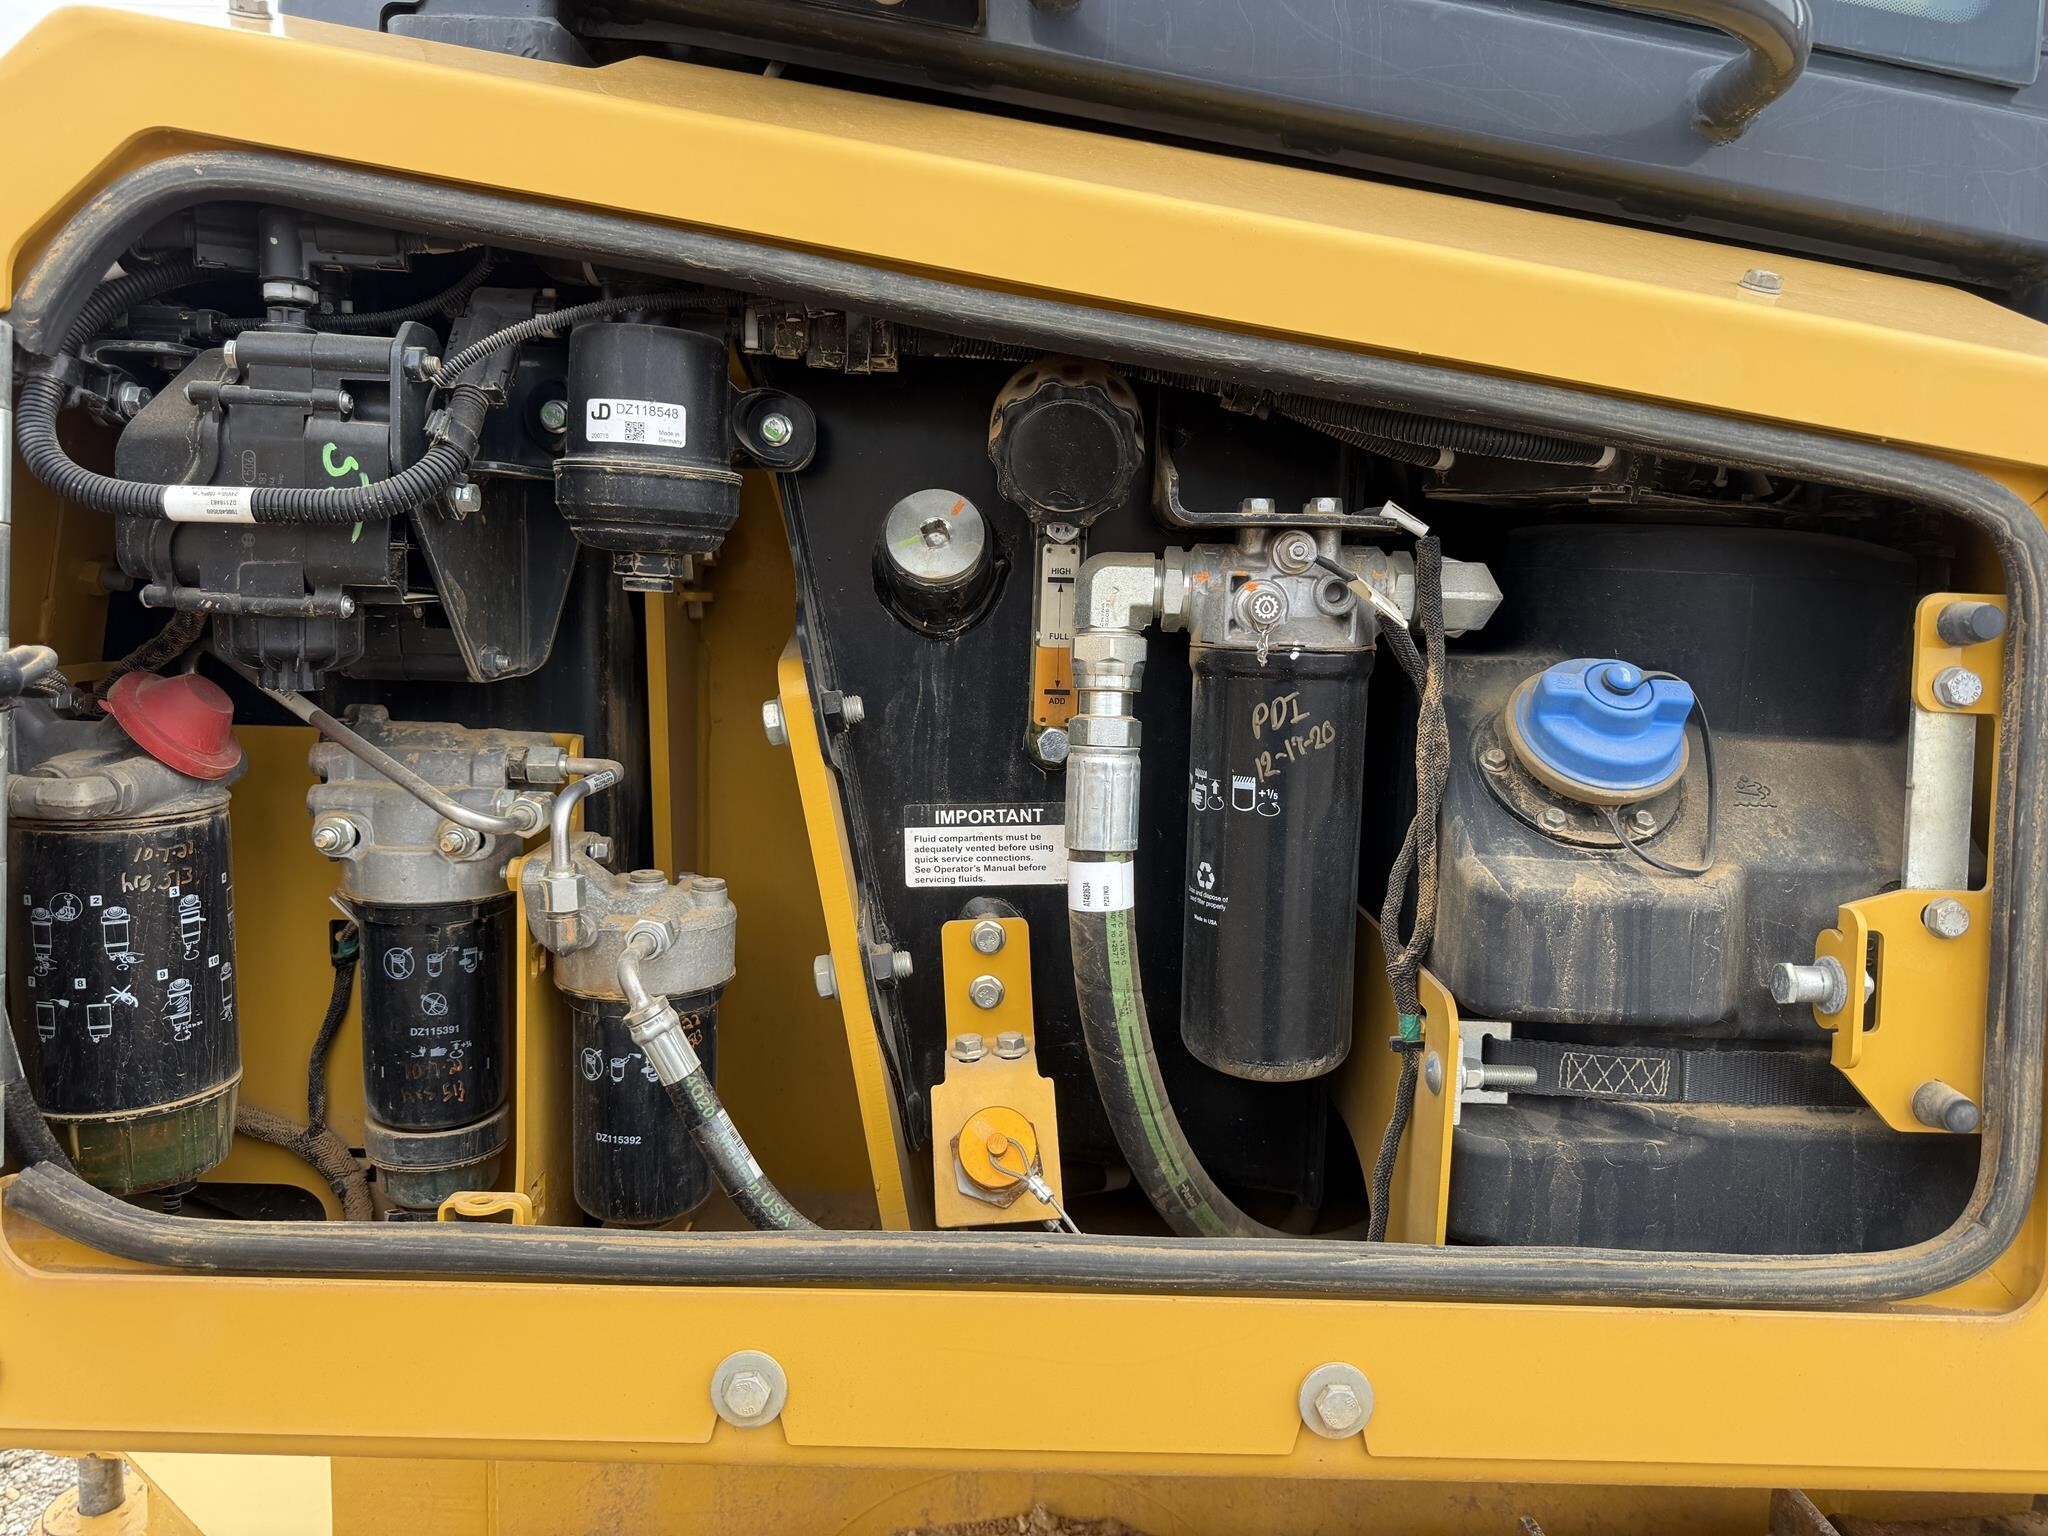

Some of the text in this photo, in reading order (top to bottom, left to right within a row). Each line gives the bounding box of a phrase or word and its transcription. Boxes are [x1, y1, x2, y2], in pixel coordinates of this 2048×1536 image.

[616, 403, 679, 420] DZ118548
[1051, 567, 1071, 575] HIGH
[1252, 691, 1311, 739] PDI
[935, 808, 1044, 824] IMPORTANT
[914, 835, 936, 843] Fluid
[939, 834, 1003, 843] compartments
[914, 845, 962, 854] adequately
[1029, 844, 1054, 852] using
[915, 855, 939, 863] quick
[934, 865, 981, 873] Operator's
[984, 864, 1016, 872] Manual
[158, 867, 192, 889] 513
[915, 875, 986, 884] servicing fluids.
[170, 888, 179, 896] 3
[1203, 892, 1221, 901] dispose
[91, 896, 101, 905] 2
[1206, 902, 1226, 911] properly
[209, 956, 218, 966] 10
[158, 970, 167, 979] 9
[76, 979, 85, 988] 8
[410, 1025, 460, 1036] DZ115391
[686, 1076, 715, 1118] 4Q20
[596, 1133, 642, 1144] DZ115392
[720, 1132, 748, 1177] Made
[761, 1192, 791, 1227] USA
